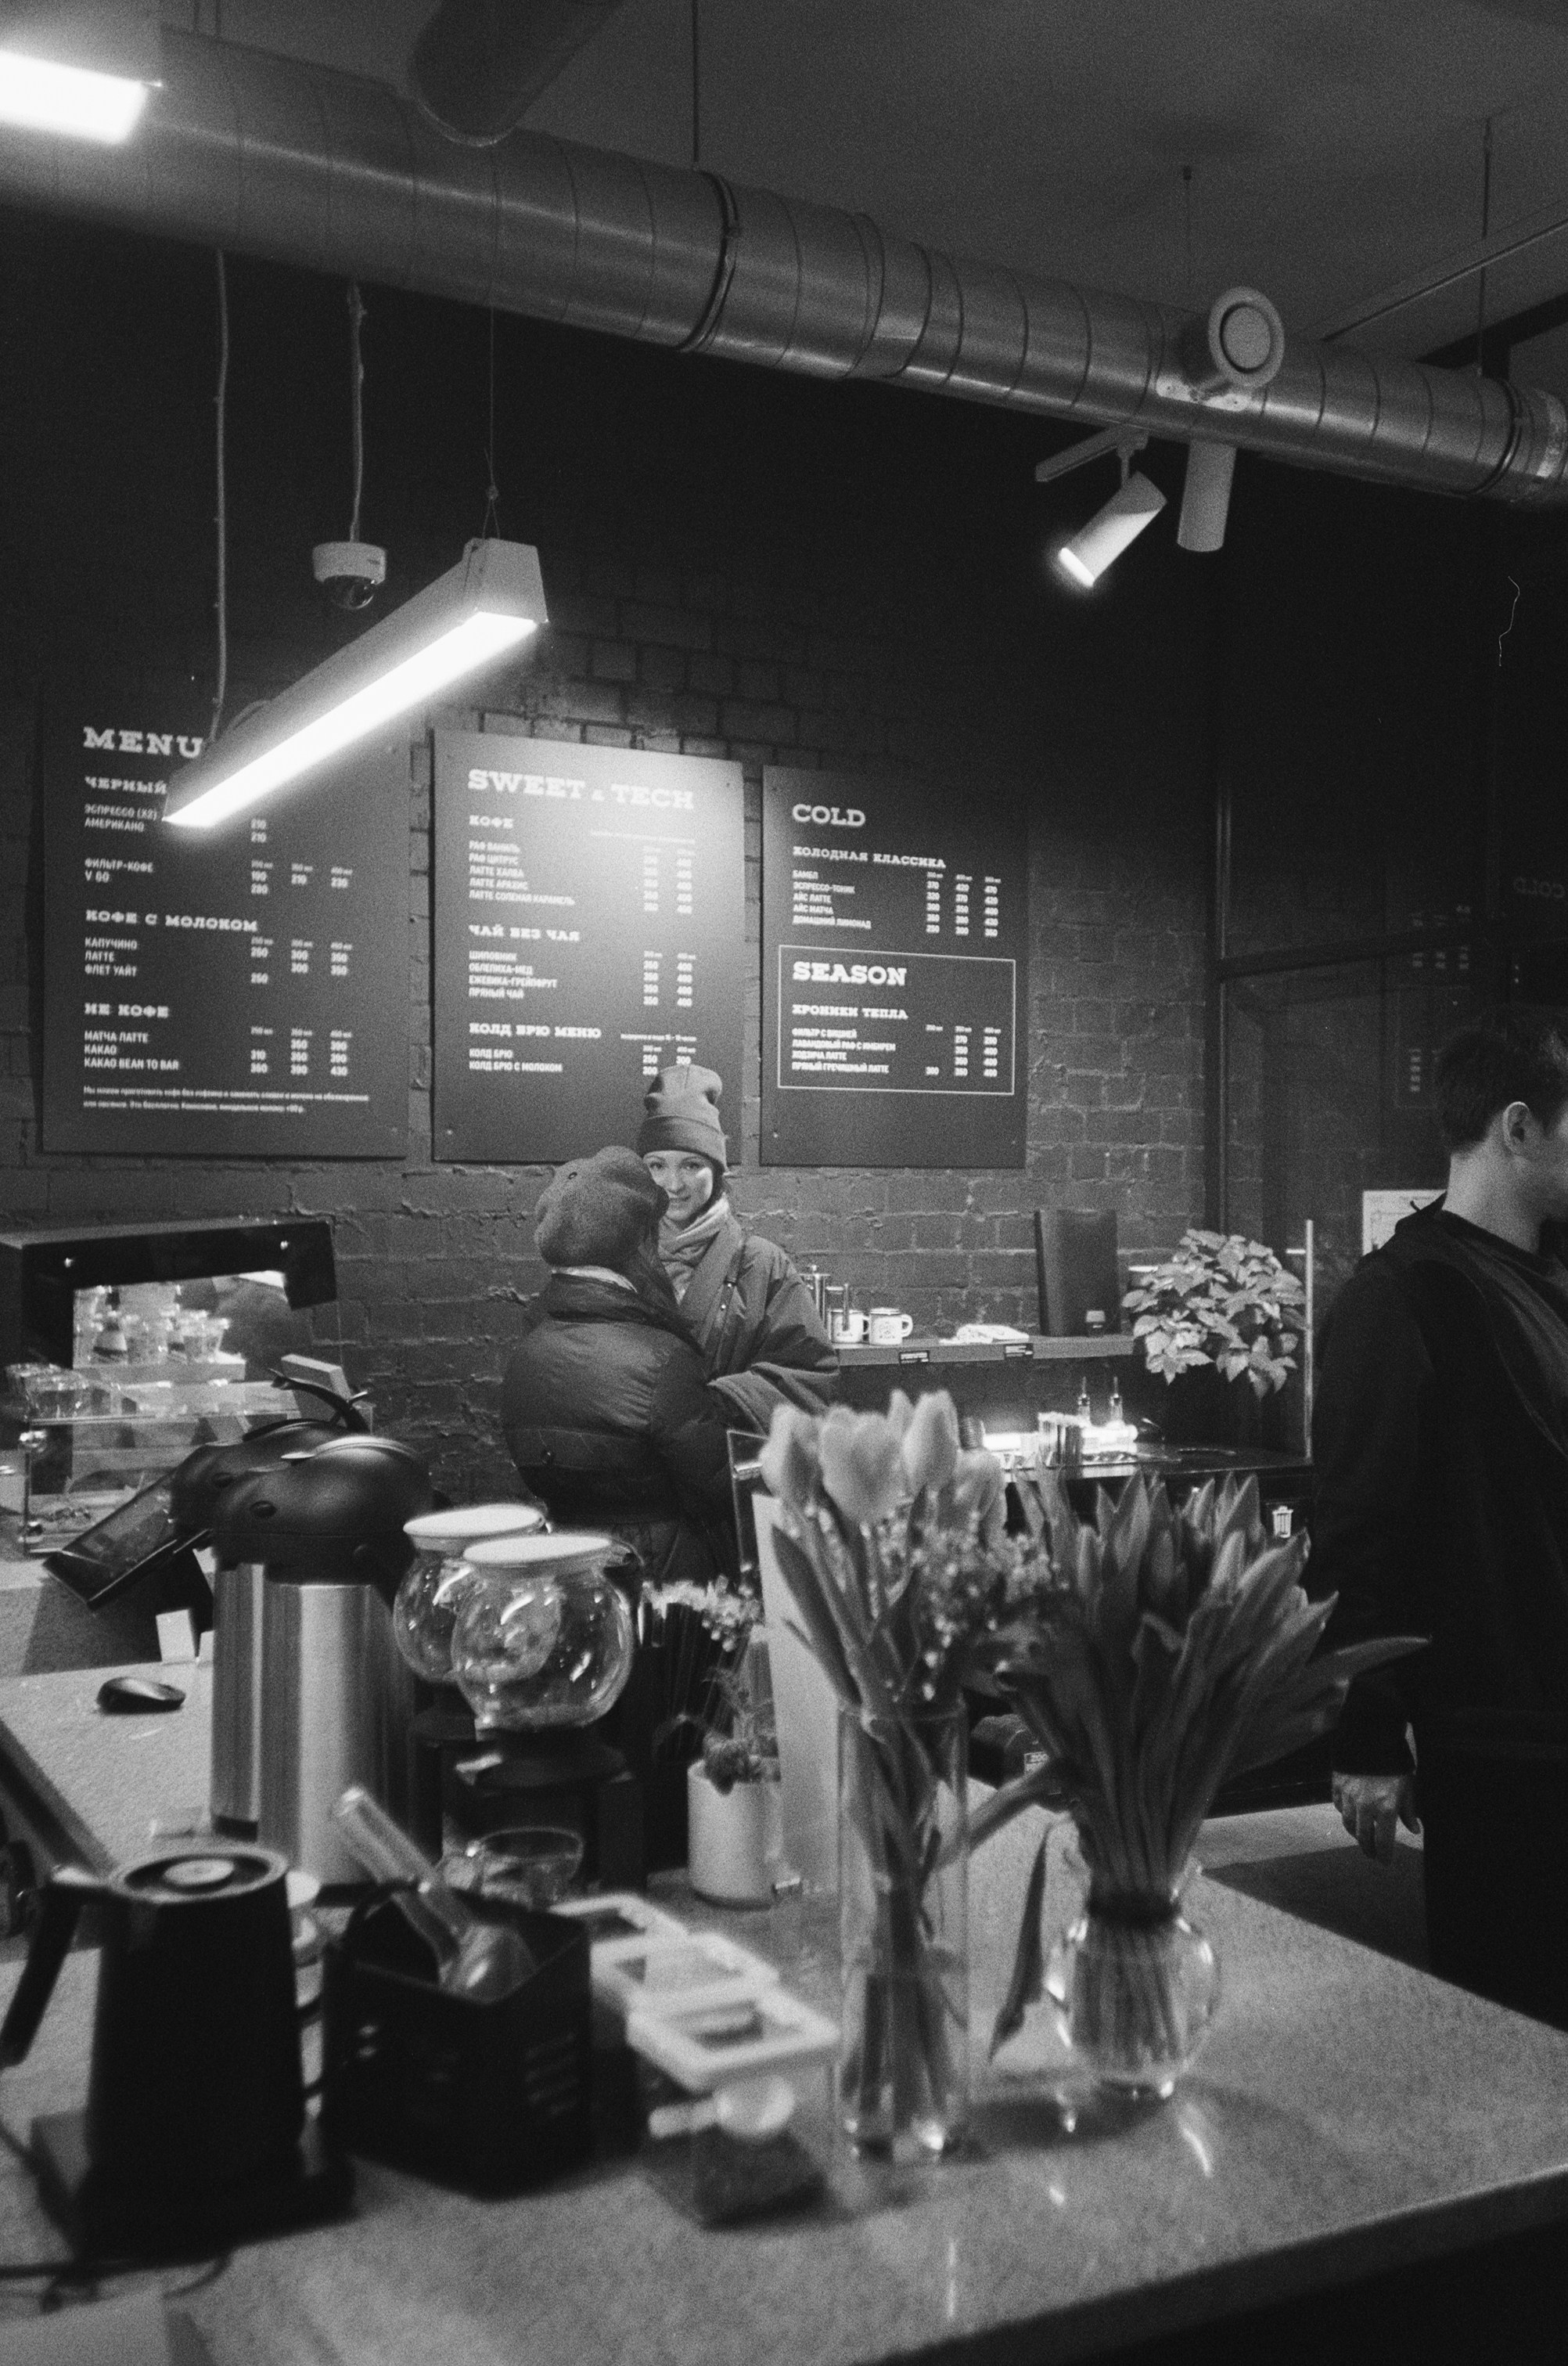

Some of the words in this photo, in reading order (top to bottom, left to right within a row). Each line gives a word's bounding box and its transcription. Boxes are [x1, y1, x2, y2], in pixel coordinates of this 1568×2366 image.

[83, 726, 203, 758] MENU
[85, 775, 167, 795] ЧЕРНЫЙ
[468, 768, 585, 800] SWEET
[611, 783, 695, 810] TECH
[85, 802, 135, 819] ЭСПРЕССО
[792, 802, 866, 828] COLD
[85, 816, 145, 833] АМЕРИКАНО
[469, 814, 514, 830] КОФЕ
[792, 845, 869, 863] ХОЛОДНАЯ
[872, 852, 947, 870] КЛАССИКА
[85, 858, 154, 873] ФИЛЬТР-КОФЕ
[469, 865, 494, 877] ЛАТТЕ
[496, 866, 524, 879] ХАЛВА
[792, 870, 818, 880] БАМБЛ
[469, 877, 494, 889] ЛАТТЕ
[496, 878, 529, 891] АРАХИС
[793, 880, 855, 895] ЭСПРЕССО-ТОНИК
[469, 889, 494, 901] ЛАТТЕ
[494, 891, 532, 903] СОЛЕНАЯ
[533, 893, 575, 906] КАРАМЕЛЬ
[793, 891, 808, 902] АЙС
[809, 893, 832, 904] ЛАТТЕ
[793, 902, 808, 913] АЙС
[809, 905, 834, 915] МАТЧА
[86, 909, 138, 924] КОФЕ
[145, 913, 158, 926] С
[165, 914, 258, 932] МОЛОКОМ
[792, 915, 836, 925] ДОМАШНИЙ
[836, 918, 872, 929] ЛИМОНАД
[468, 924, 505, 938] ЧАЙ
[509, 927, 541, 940] БЕЗ
[545, 929, 581, 942] ЧАЯ
[85, 937, 138, 951] КАПУЧИНО
[85, 950, 115, 963] ЛАТТЕ
[469, 949, 518, 963] ШИПОВНИК
[85, 963, 111, 976] ФЛЕТ
[113, 963, 138, 978] УАЙТ
[469, 962, 534, 976] ОБЛЕПИХА-МЕД
[792, 961, 907, 987] SEASON
[469, 974, 558, 989] ЕЖЕВИКА-ГРЕЙПФРУТ
[469, 986, 505, 999] ПРЯНЫЙ
[506, 987, 524, 999] ЧАЙ
[85, 1002, 111, 1016] НЕ
[118, 1004, 170, 1018] КОФЕ
[792, 1003, 858, 1018] ХРОНИКИ
[862, 1007, 908, 1021] ТЕПЛА
[84, 1030, 117, 1043] МАТЧА
[119, 1032, 149, 1044] ЛАТТЕ
[469, 1022, 512, 1038] КОЛД
[516, 1024, 551, 1037] БРЮ
[554, 1025, 602, 1039] МЕНЮ
[792, 1027, 820, 1037] ФИЛЬТР
[827, 1028, 858, 1039] ВИШНЕЙ
[84, 1044, 117, 1056] КАКАО
[792, 1039, 841, 1050] ЛАВАНДОВЫЙ
[841, 1041, 856, 1050] РАФ
[856, 1041, 863, 1050] С
[862, 1042, 896, 1051] ИМБИРЕМ
[469, 1048, 492, 1060] КОЛД
[493, 1048, 513, 1060] БРЮ
[825, 1051, 847, 1061] ЛАТТЕ
[84, 1057, 117, 1069] КАКАО
[119, 1057, 144, 1070] BEAN
[469, 1060, 492, 1072] КОЛД
[493, 1061, 512, 1071] БРЮ
[513, 1061, 520, 1072] С
[521, 1061, 563, 1073] МОЛОКОМ
[792, 1061, 822, 1071] ПРЯНЫЙ
[822, 1062, 868, 1072] ГРЕЧИШНЫЙ
[868, 1064, 890, 1074] ЛАТТЕ
